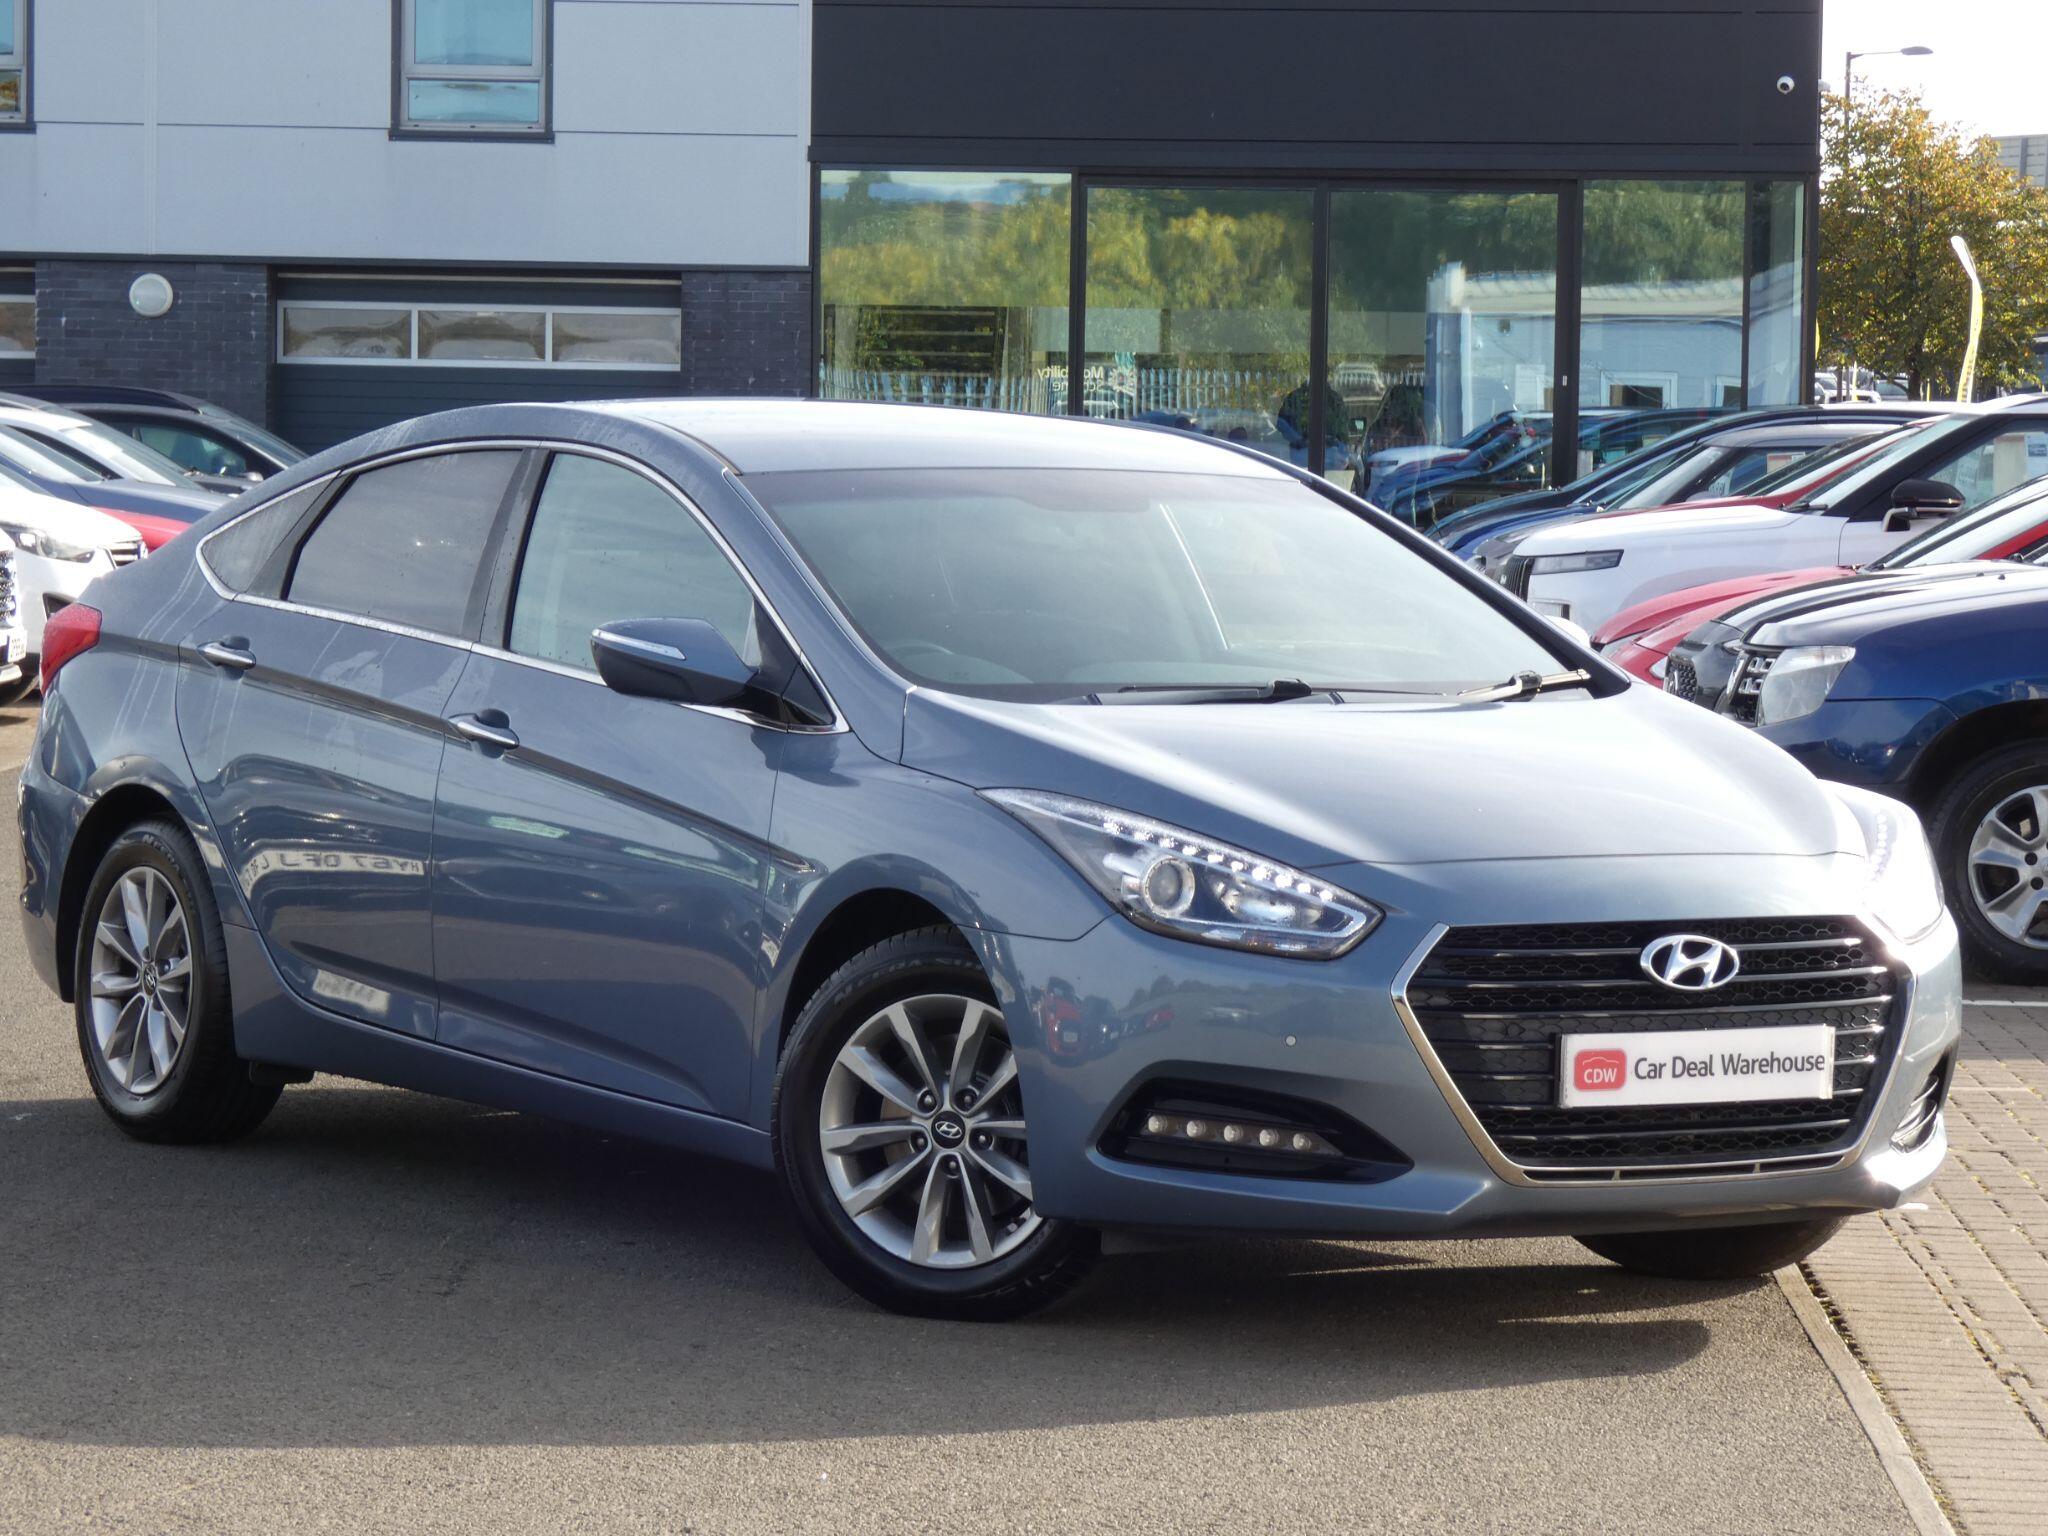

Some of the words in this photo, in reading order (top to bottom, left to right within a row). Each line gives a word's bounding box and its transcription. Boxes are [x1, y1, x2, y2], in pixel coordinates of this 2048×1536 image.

[1583, 1067, 1618, 1084] CDW
[1633, 1057, 1667, 1080] Car
[1671, 1054, 1715, 1078] Deal
[1720, 1051, 1826, 1076] Warehouse
